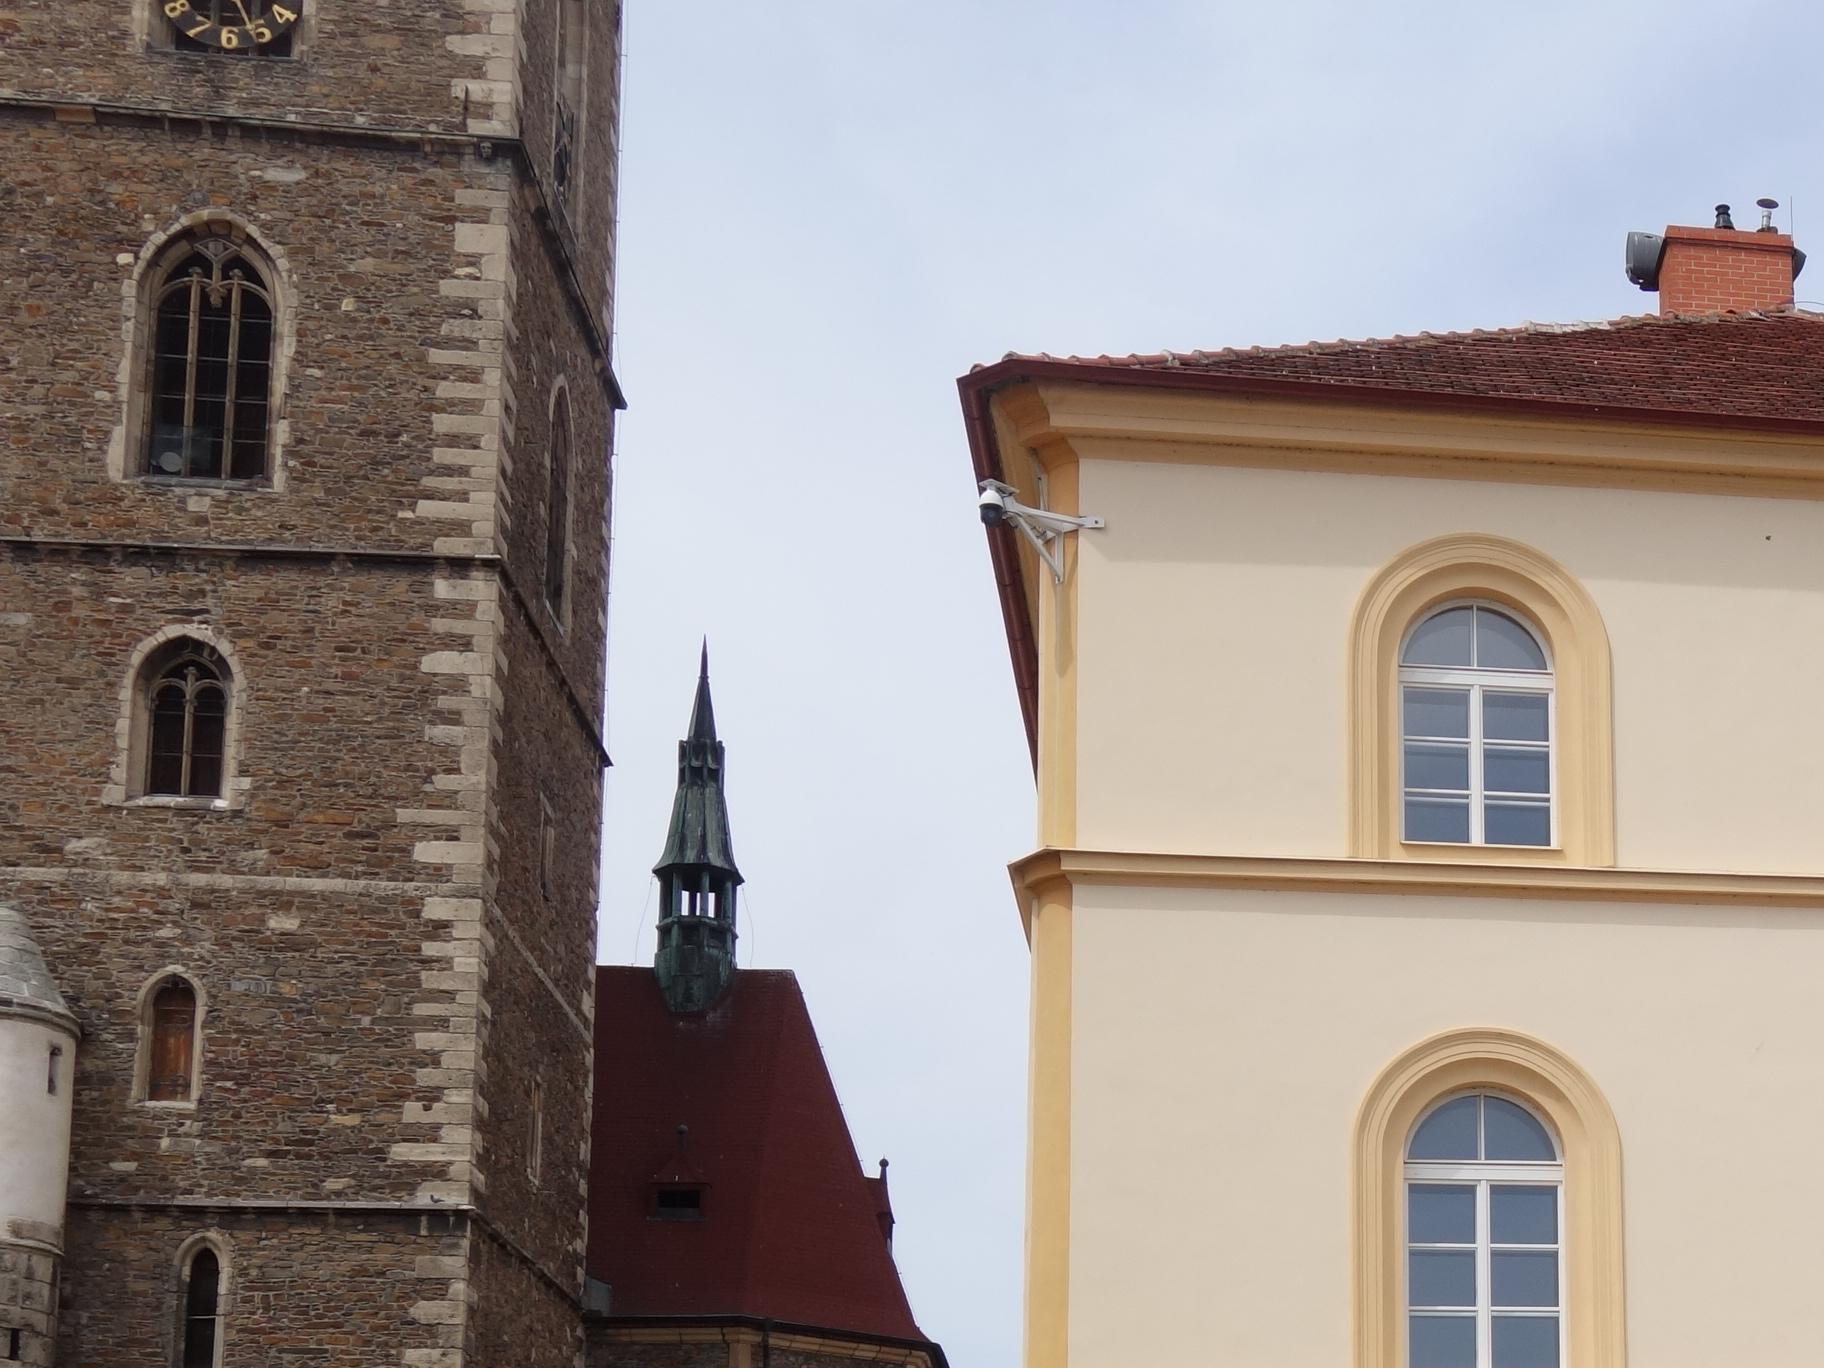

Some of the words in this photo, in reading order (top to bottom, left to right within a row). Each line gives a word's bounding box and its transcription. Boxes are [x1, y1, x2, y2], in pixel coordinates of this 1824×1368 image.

[164, 0, 190, 18] 8
[272, 4, 297, 23] 4
[186, 14, 212, 38] 7
[221, 26, 239, 48] 6
[252, 19, 272, 43] 5
